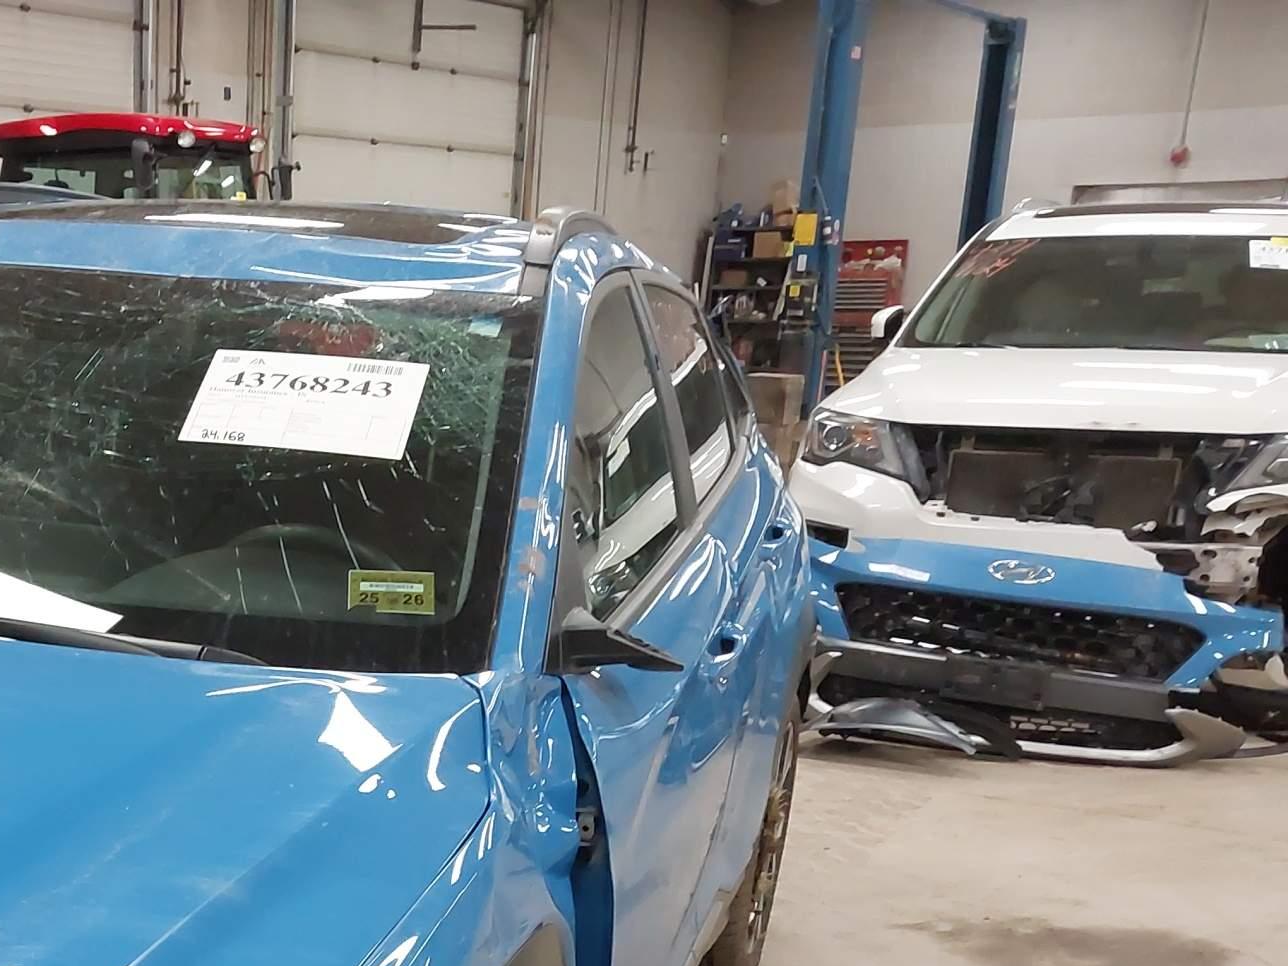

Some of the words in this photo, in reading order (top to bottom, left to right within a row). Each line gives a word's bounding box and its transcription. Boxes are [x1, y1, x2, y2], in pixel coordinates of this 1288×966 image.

[225, 370, 394, 398] 43768243
[359, 592, 380, 604] 25
[403, 593, 425, 606] 26
